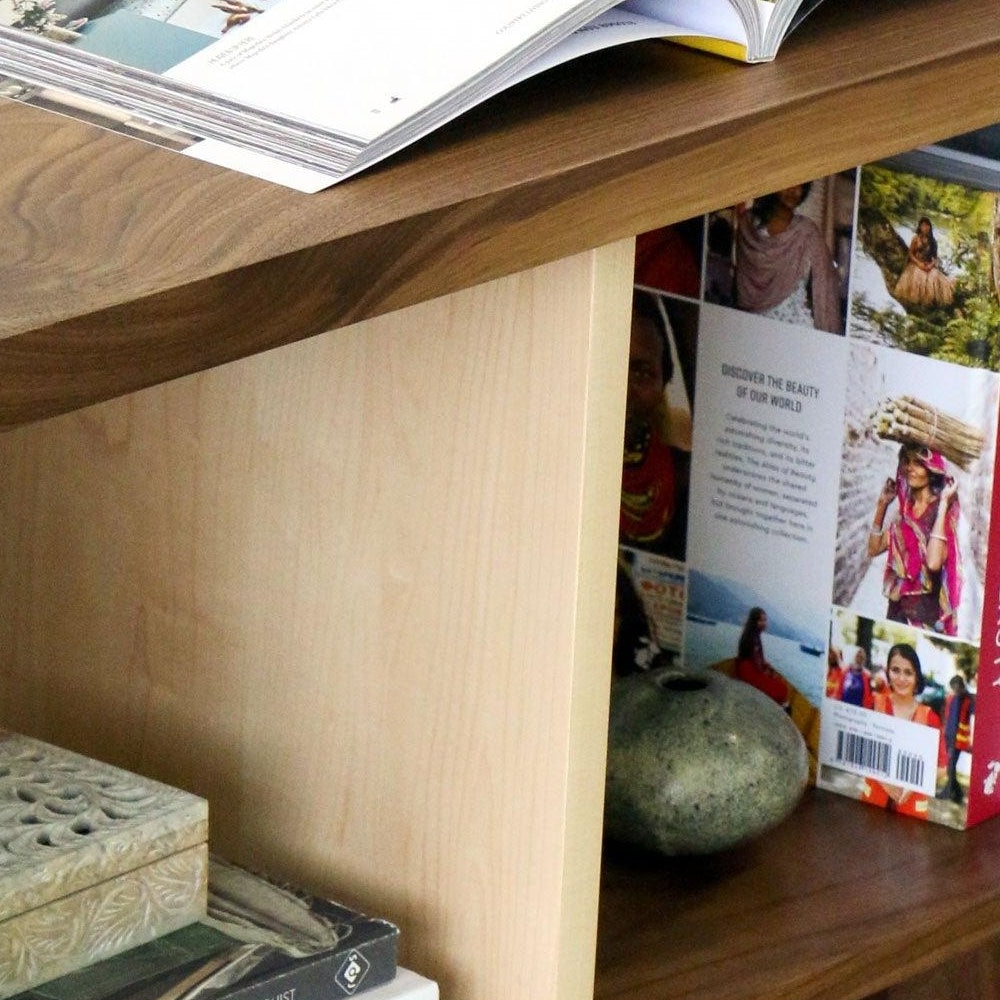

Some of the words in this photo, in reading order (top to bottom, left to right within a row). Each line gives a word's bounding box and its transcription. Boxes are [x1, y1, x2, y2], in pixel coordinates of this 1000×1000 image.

[722, 363, 765, 385] DISCOVER
[768, 375, 784, 390] THE
[786, 380, 820, 399] BEAUTY
[736, 385, 748, 398] OF
[750, 389, 768, 404] OUR
[771, 395, 802, 413] WORLD
